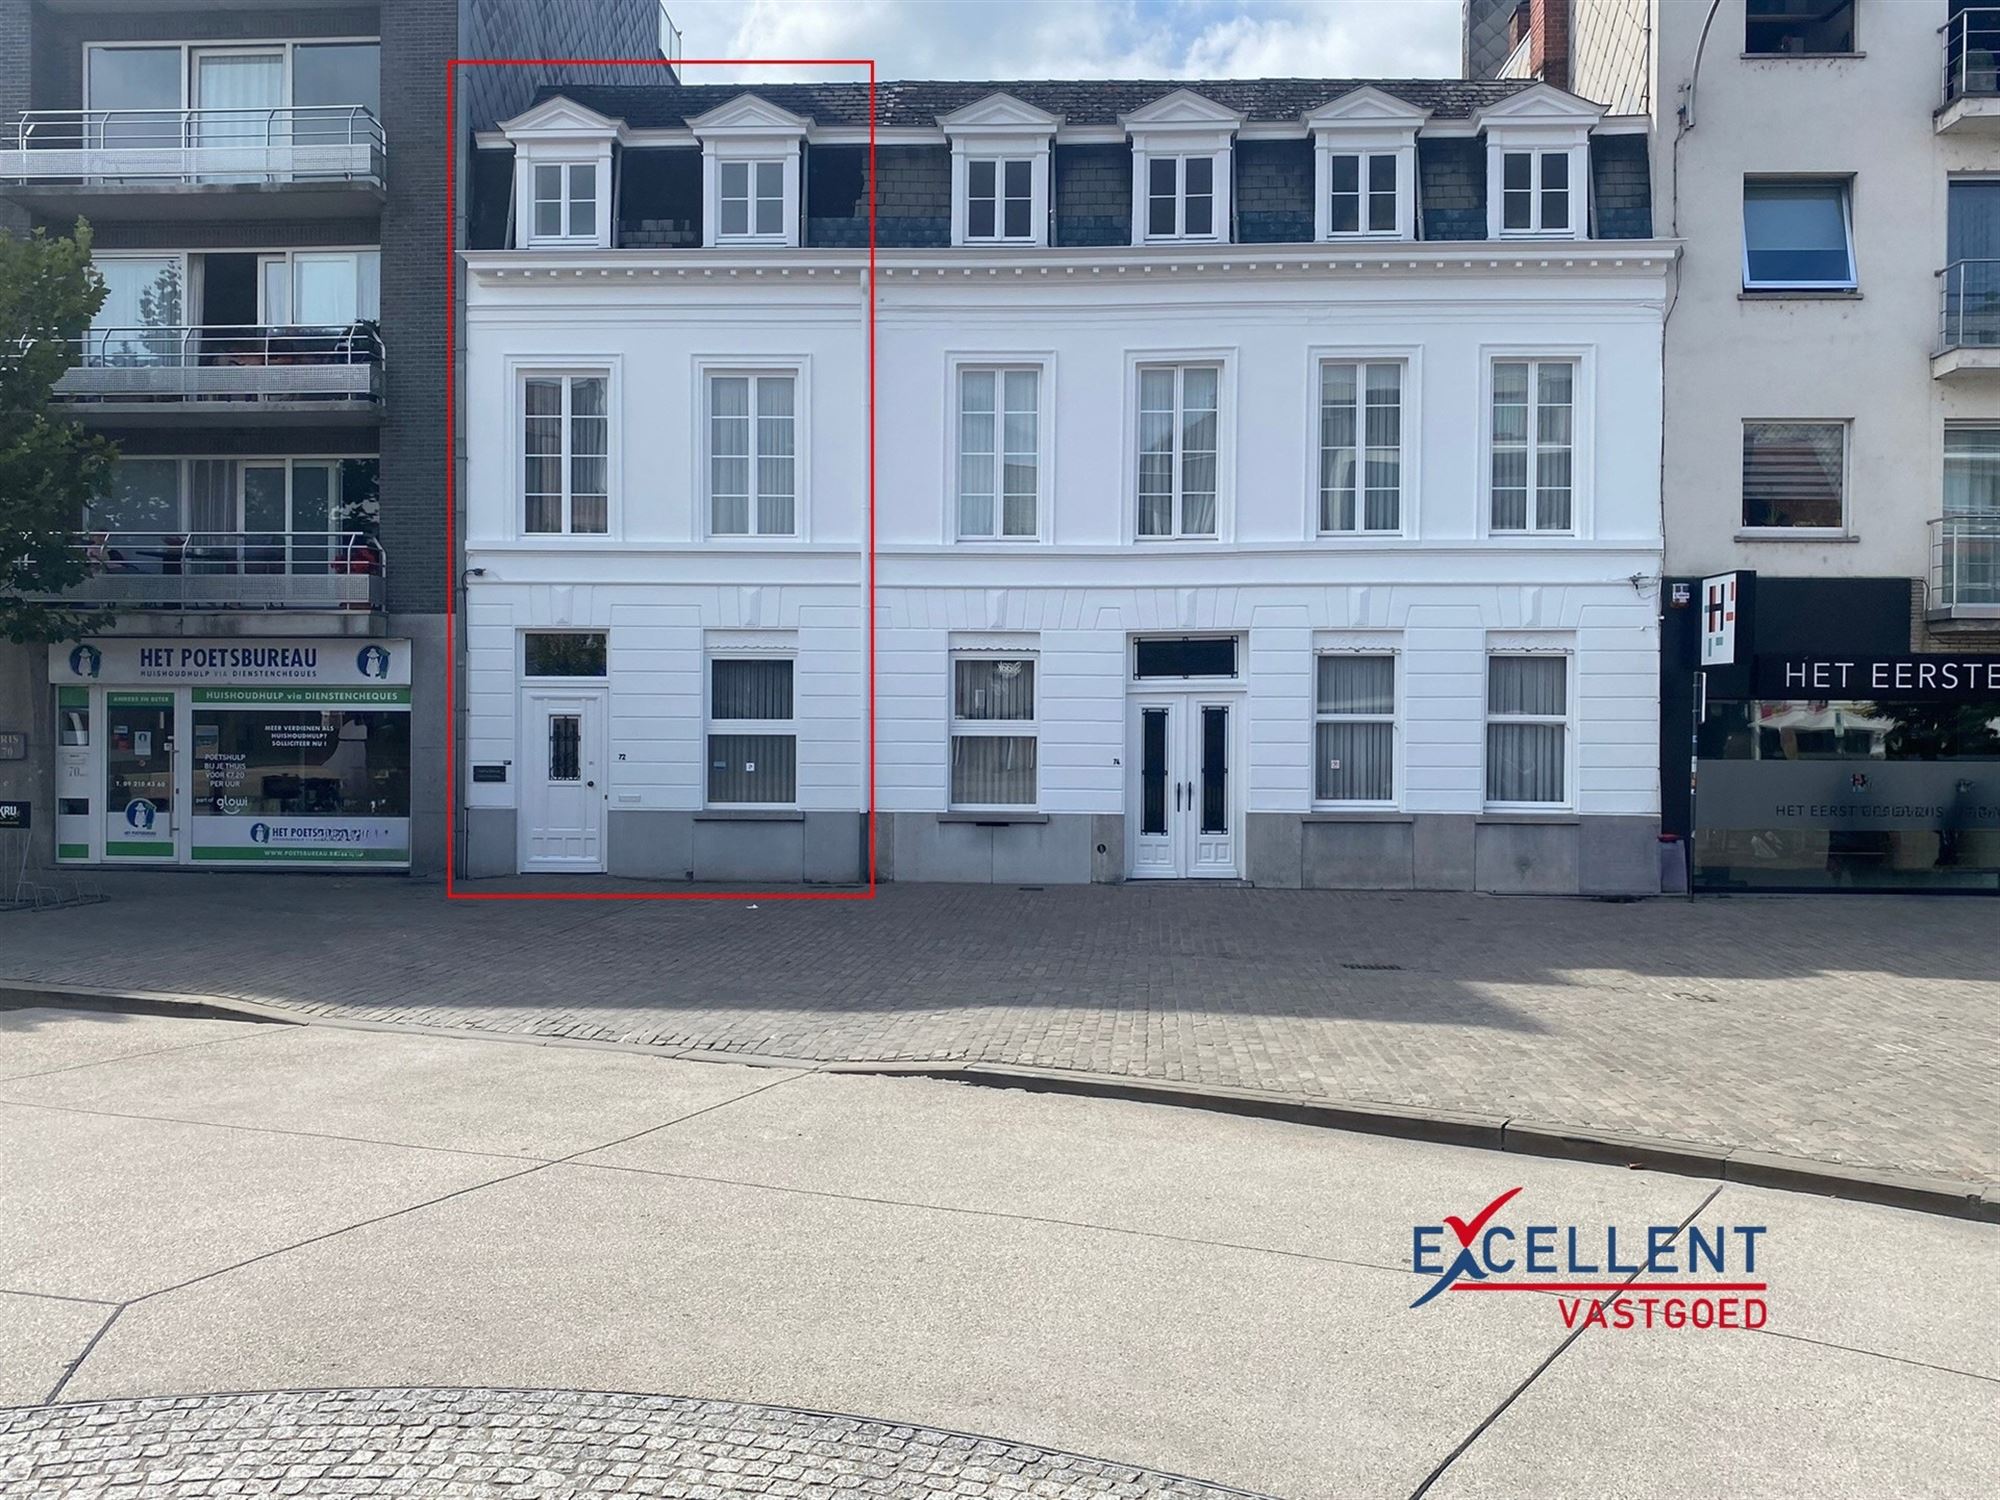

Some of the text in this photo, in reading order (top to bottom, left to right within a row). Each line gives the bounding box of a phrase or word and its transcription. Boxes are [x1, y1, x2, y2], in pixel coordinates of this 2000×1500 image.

[139, 648, 318, 668] HET POETSBUREAU
[140, 670, 318, 678] HUISHOUDHULP VIA DIENSTENCHEQUES
[1785, 662, 2000, 690] HET EERSTE
[205, 691, 398, 701] HUISHOUDHULP via DIENSTENCHEQUES
[271, 732, 328, 740] HUISHOUDHULP?
[271, 740, 311, 748] SOLLICITEER
[204, 753, 246, 761] POETSHULP
[618, 753, 627, 761] 72
[1112, 757, 1121, 765] 74
[225, 762, 247, 770] THUIS
[210, 780, 241, 788] PER UUR
[216, 794, 248, 810] glowi
[1776, 805, 1805, 817] HET
[272, 827, 288, 838] HET
